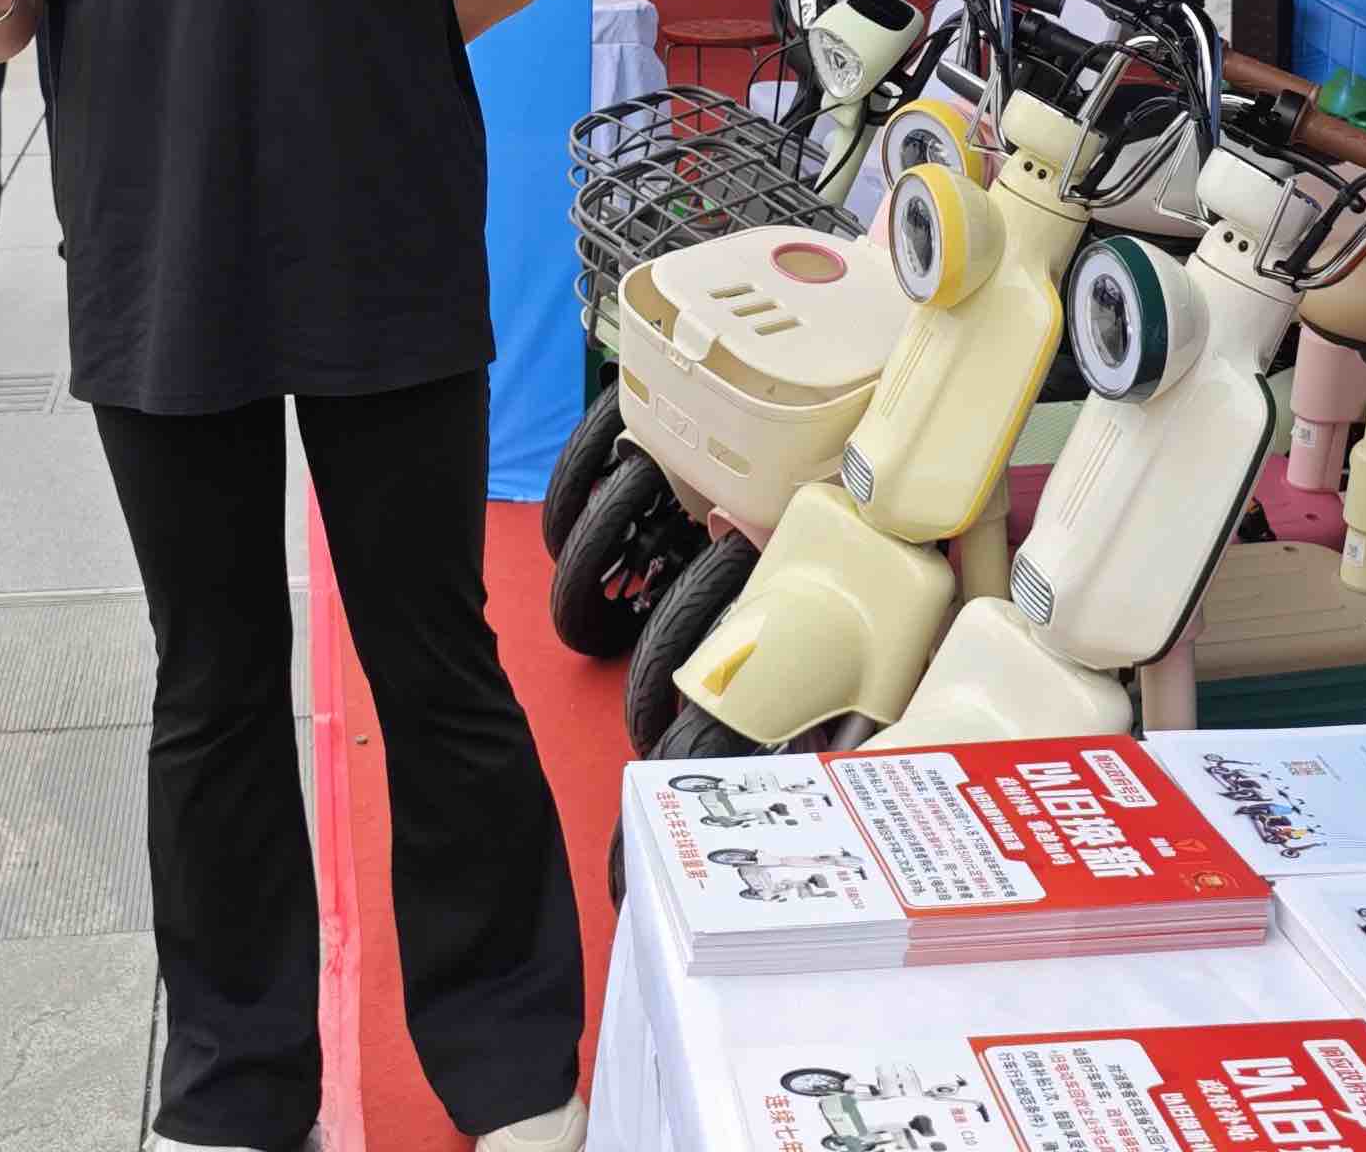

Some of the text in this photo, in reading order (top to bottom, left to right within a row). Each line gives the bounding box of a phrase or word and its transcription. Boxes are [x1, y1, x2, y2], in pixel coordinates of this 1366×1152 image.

[992, 776, 1041, 816] 政府补贴
[1012, 760, 1156, 880] 以旧换新
[1195, 1078, 1262, 1141] 政府补贴
[1222, 1057, 1353, 1152] 以旧
